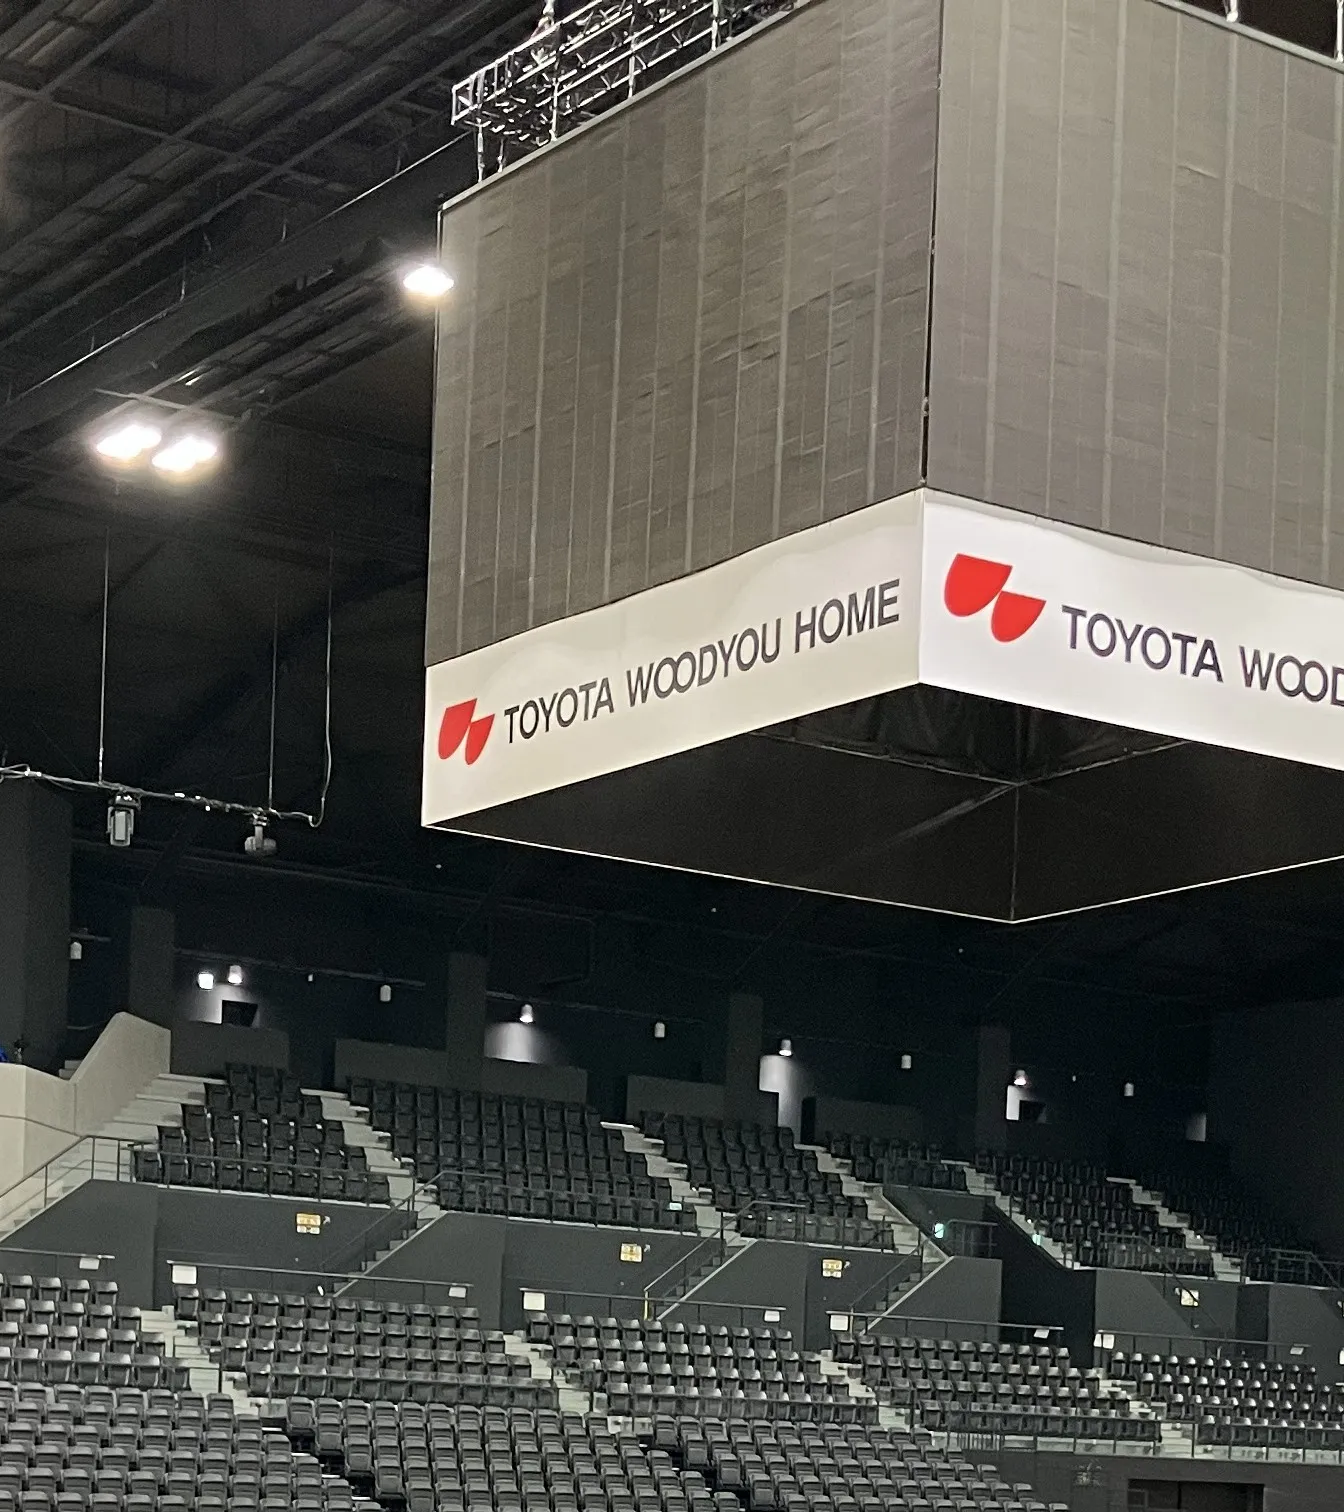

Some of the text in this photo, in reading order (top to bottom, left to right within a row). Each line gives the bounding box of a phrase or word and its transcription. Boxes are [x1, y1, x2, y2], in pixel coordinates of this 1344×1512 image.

[503, 577, 903, 748] TOYOTA WOODYOU HOME
[1061, 603, 1224, 686] TOYOTA
